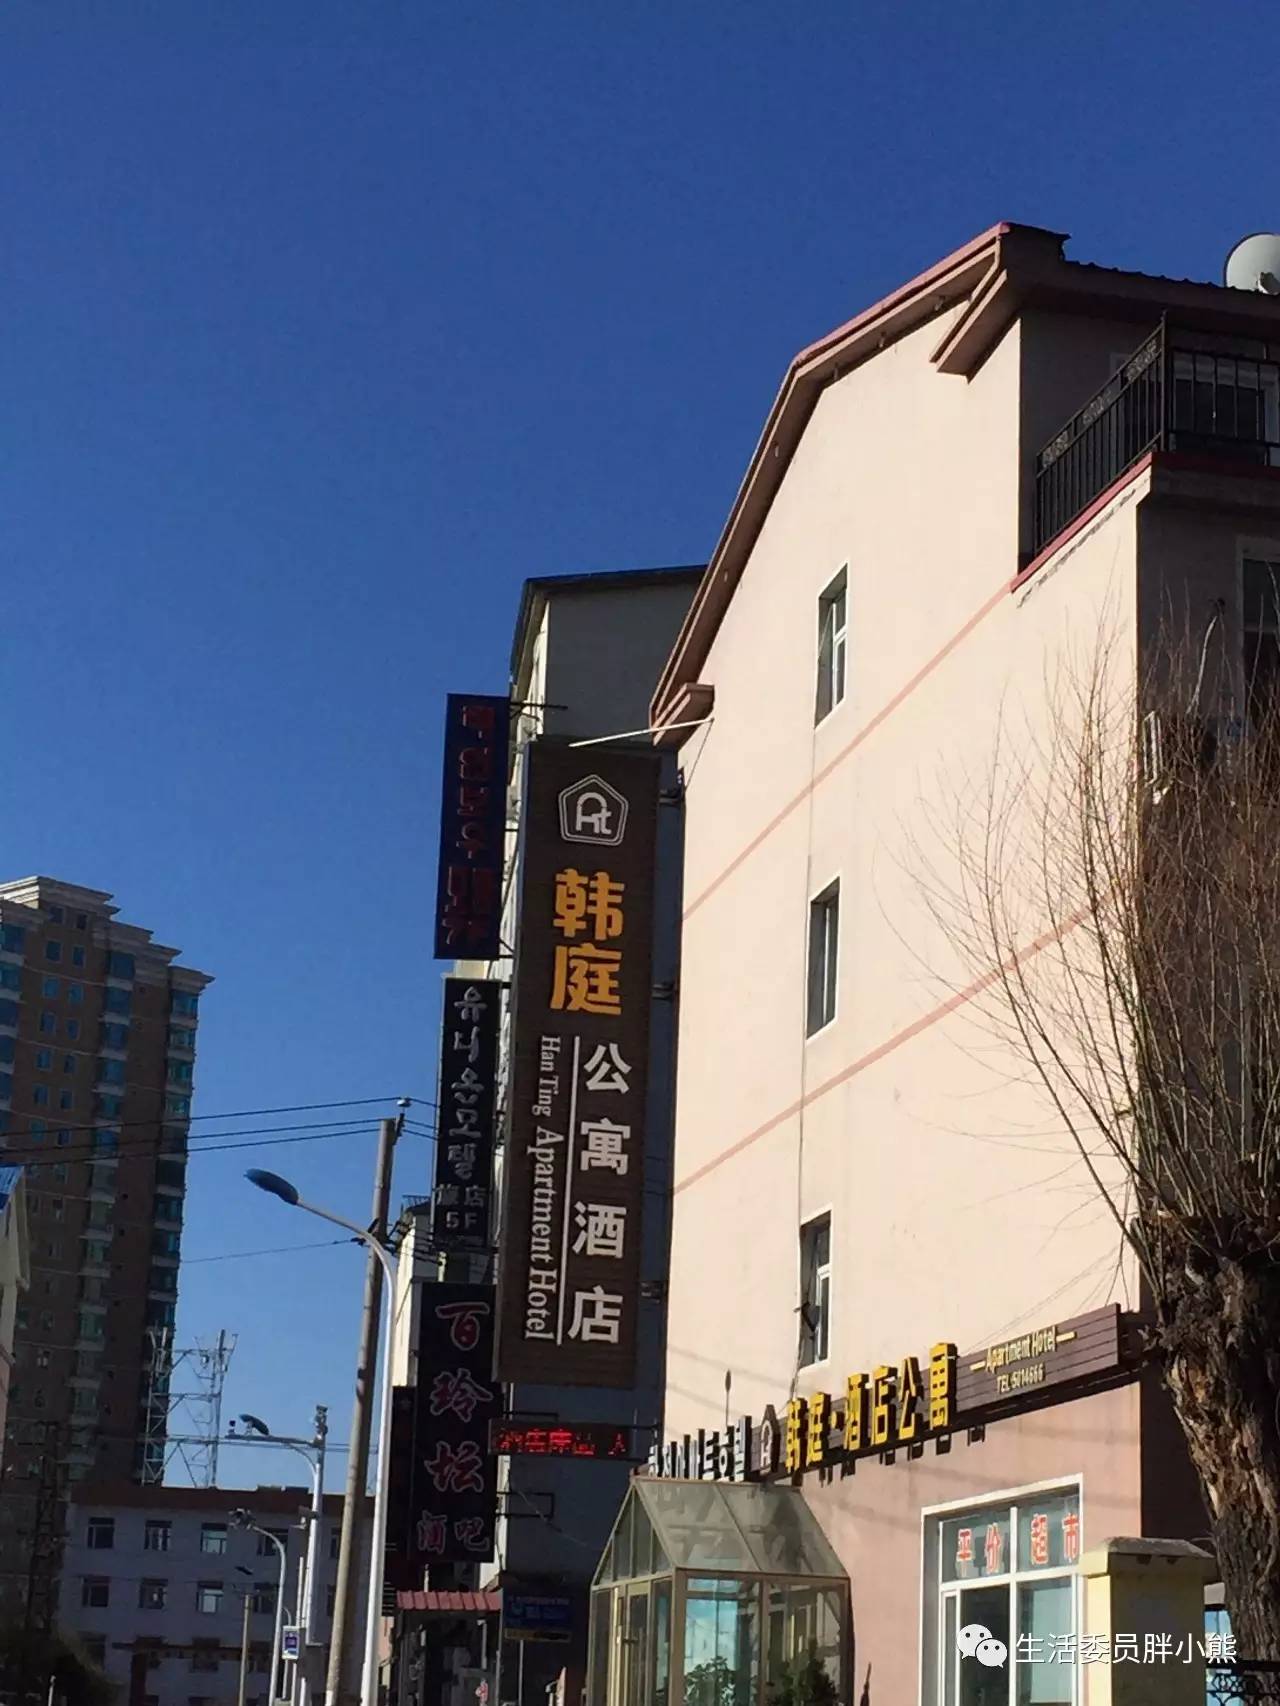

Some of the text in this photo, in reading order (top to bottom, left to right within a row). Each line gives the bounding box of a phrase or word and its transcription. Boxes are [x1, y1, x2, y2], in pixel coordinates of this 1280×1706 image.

[549, 867, 626, 1018] 韩庭
[524, 1035, 564, 1340] Han Ting Apartment Hotel
[567, 1042, 632, 1344] 公寓酒店
[985, 1325, 1057, 1374] Apartment Hotel
[956, 1511, 1080, 1575] 平价超市
